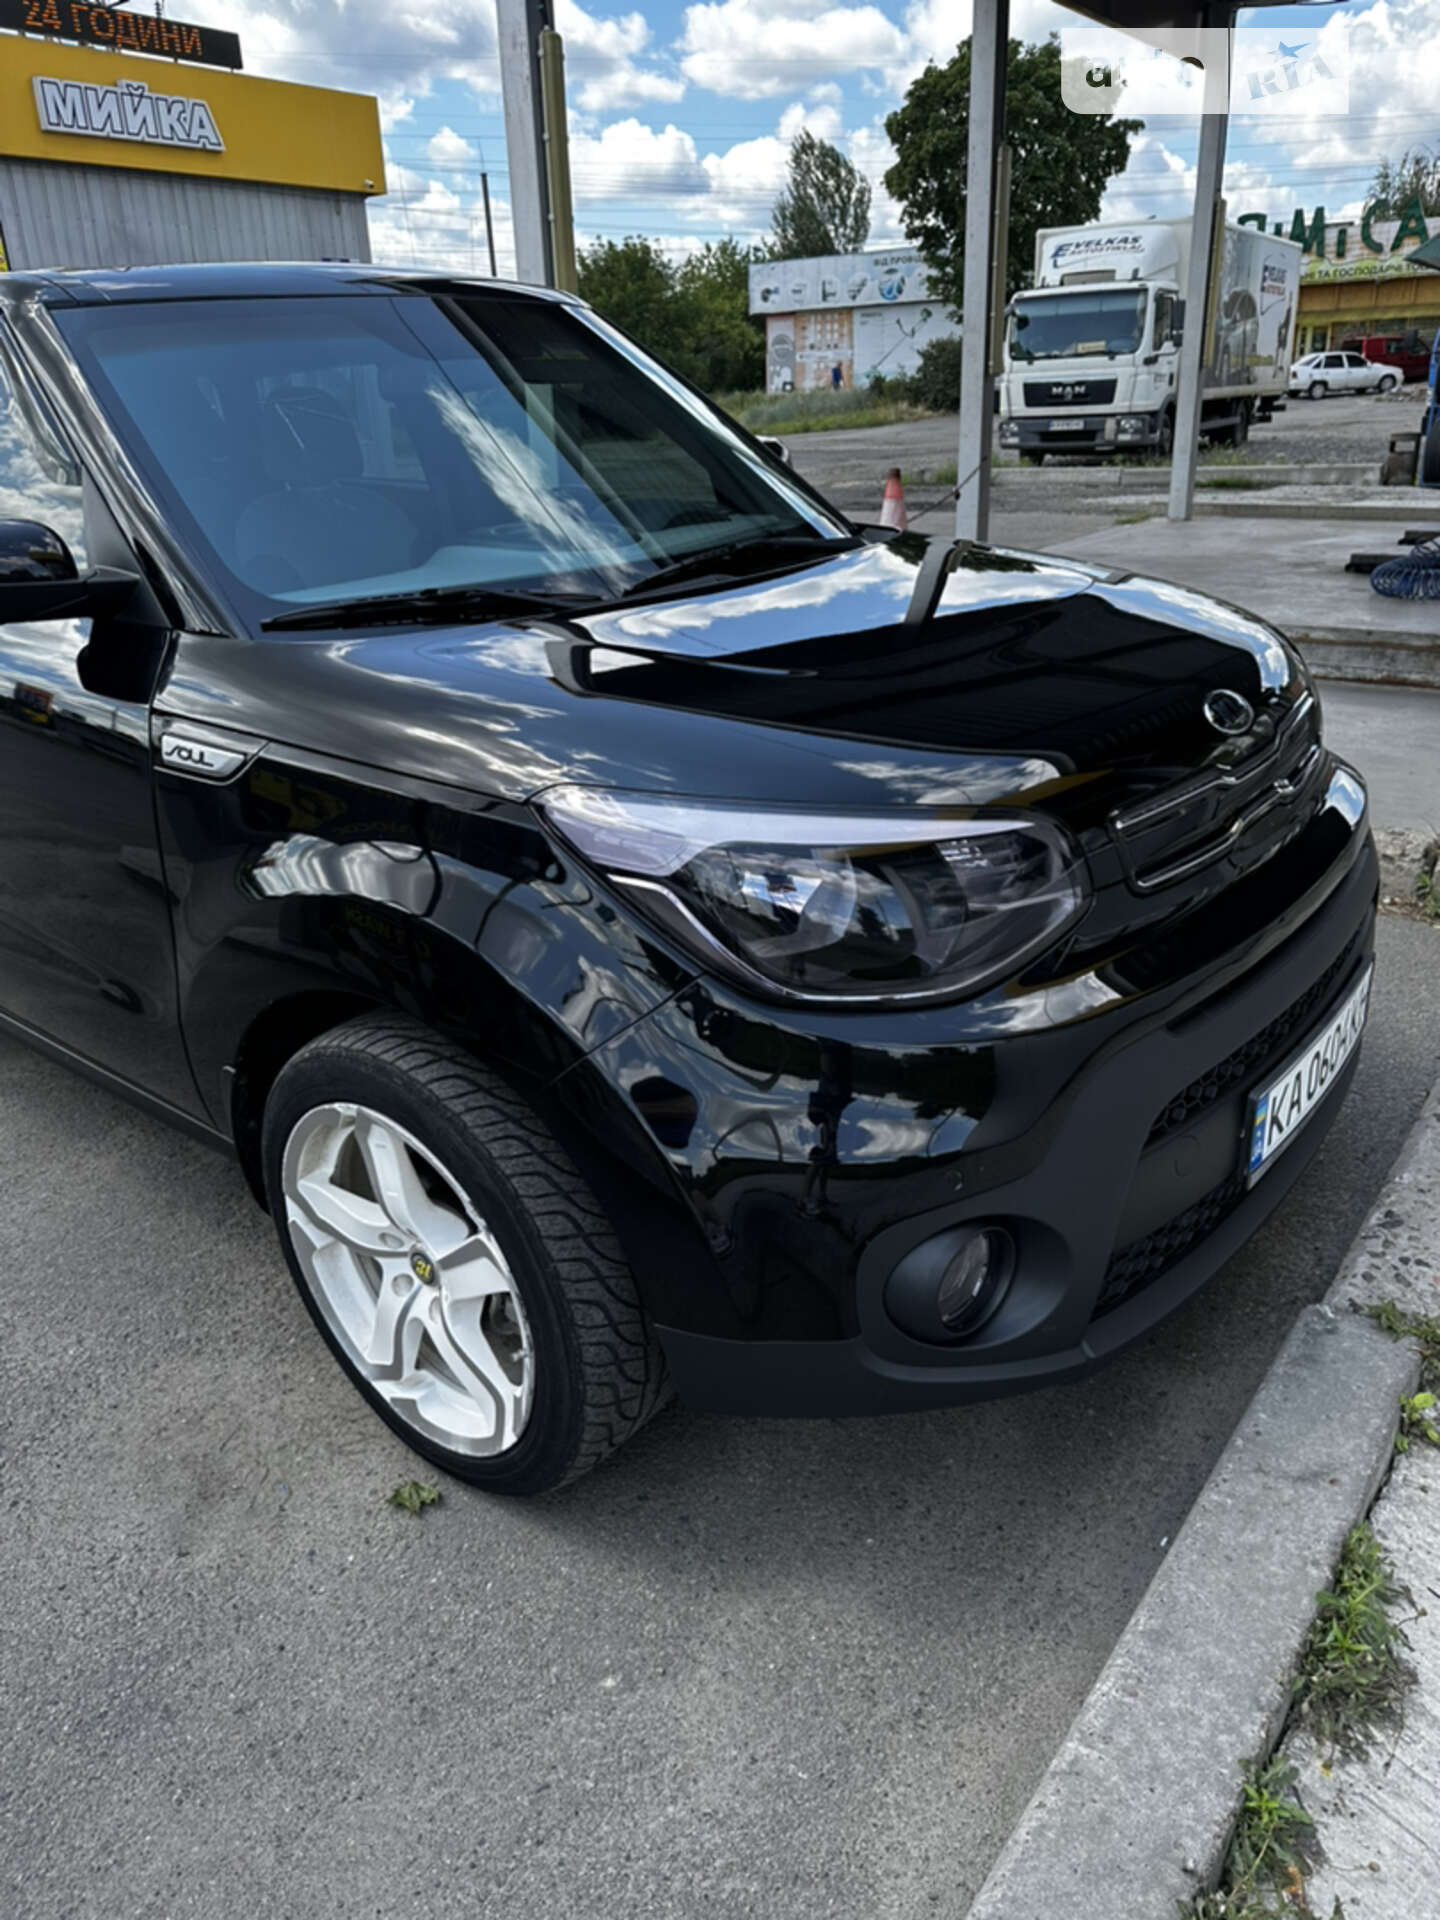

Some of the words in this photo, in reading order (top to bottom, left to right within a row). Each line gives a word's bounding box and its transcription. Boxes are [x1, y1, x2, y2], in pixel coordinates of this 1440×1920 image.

[22, 0, 62, 30] 24
[70, 3, 203, 56] ГОДИНИ
[38, 79, 223, 148] МИЙКА
[1051, 235, 1142, 258] EVELKAS
[1051, 385, 1086, 395] MAN
[165, 745, 214, 767] SOUL
